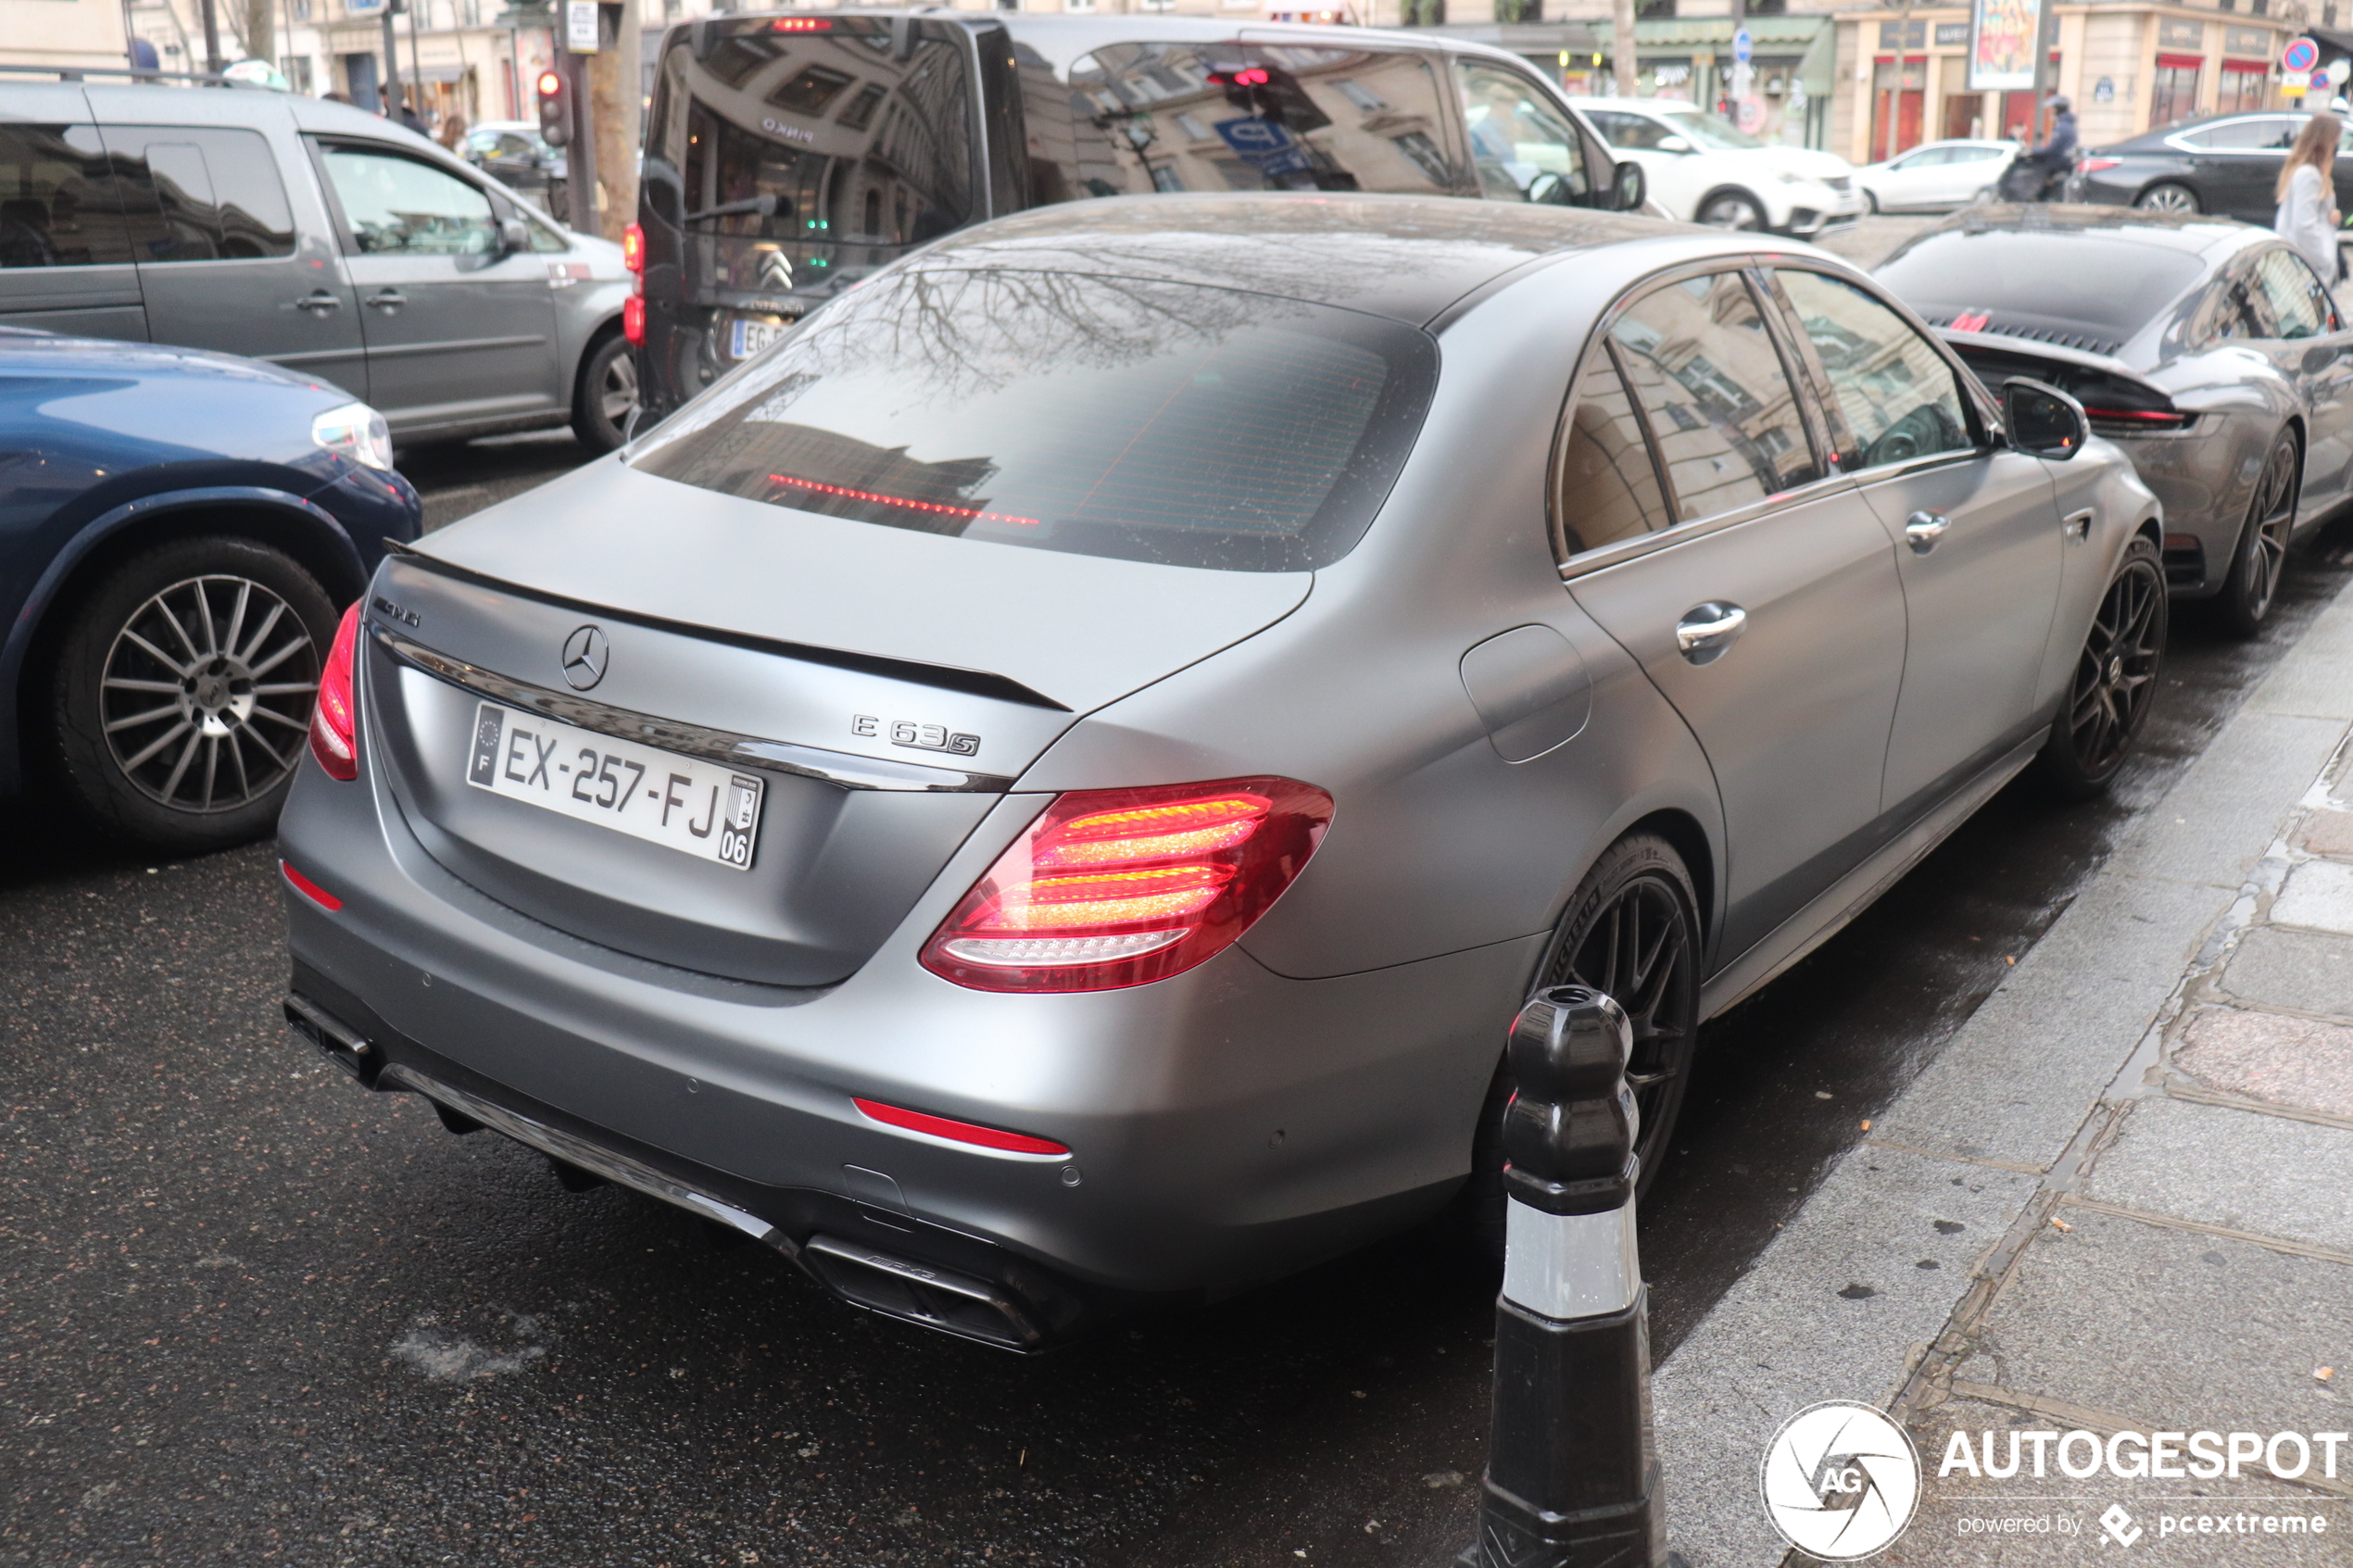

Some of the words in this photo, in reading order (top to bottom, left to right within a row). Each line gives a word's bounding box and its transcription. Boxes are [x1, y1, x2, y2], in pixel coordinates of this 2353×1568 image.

[478, 755, 491, 772] F
[505, 728, 720, 839] EX-257-FJ
[722, 831, 748, 863] 06
